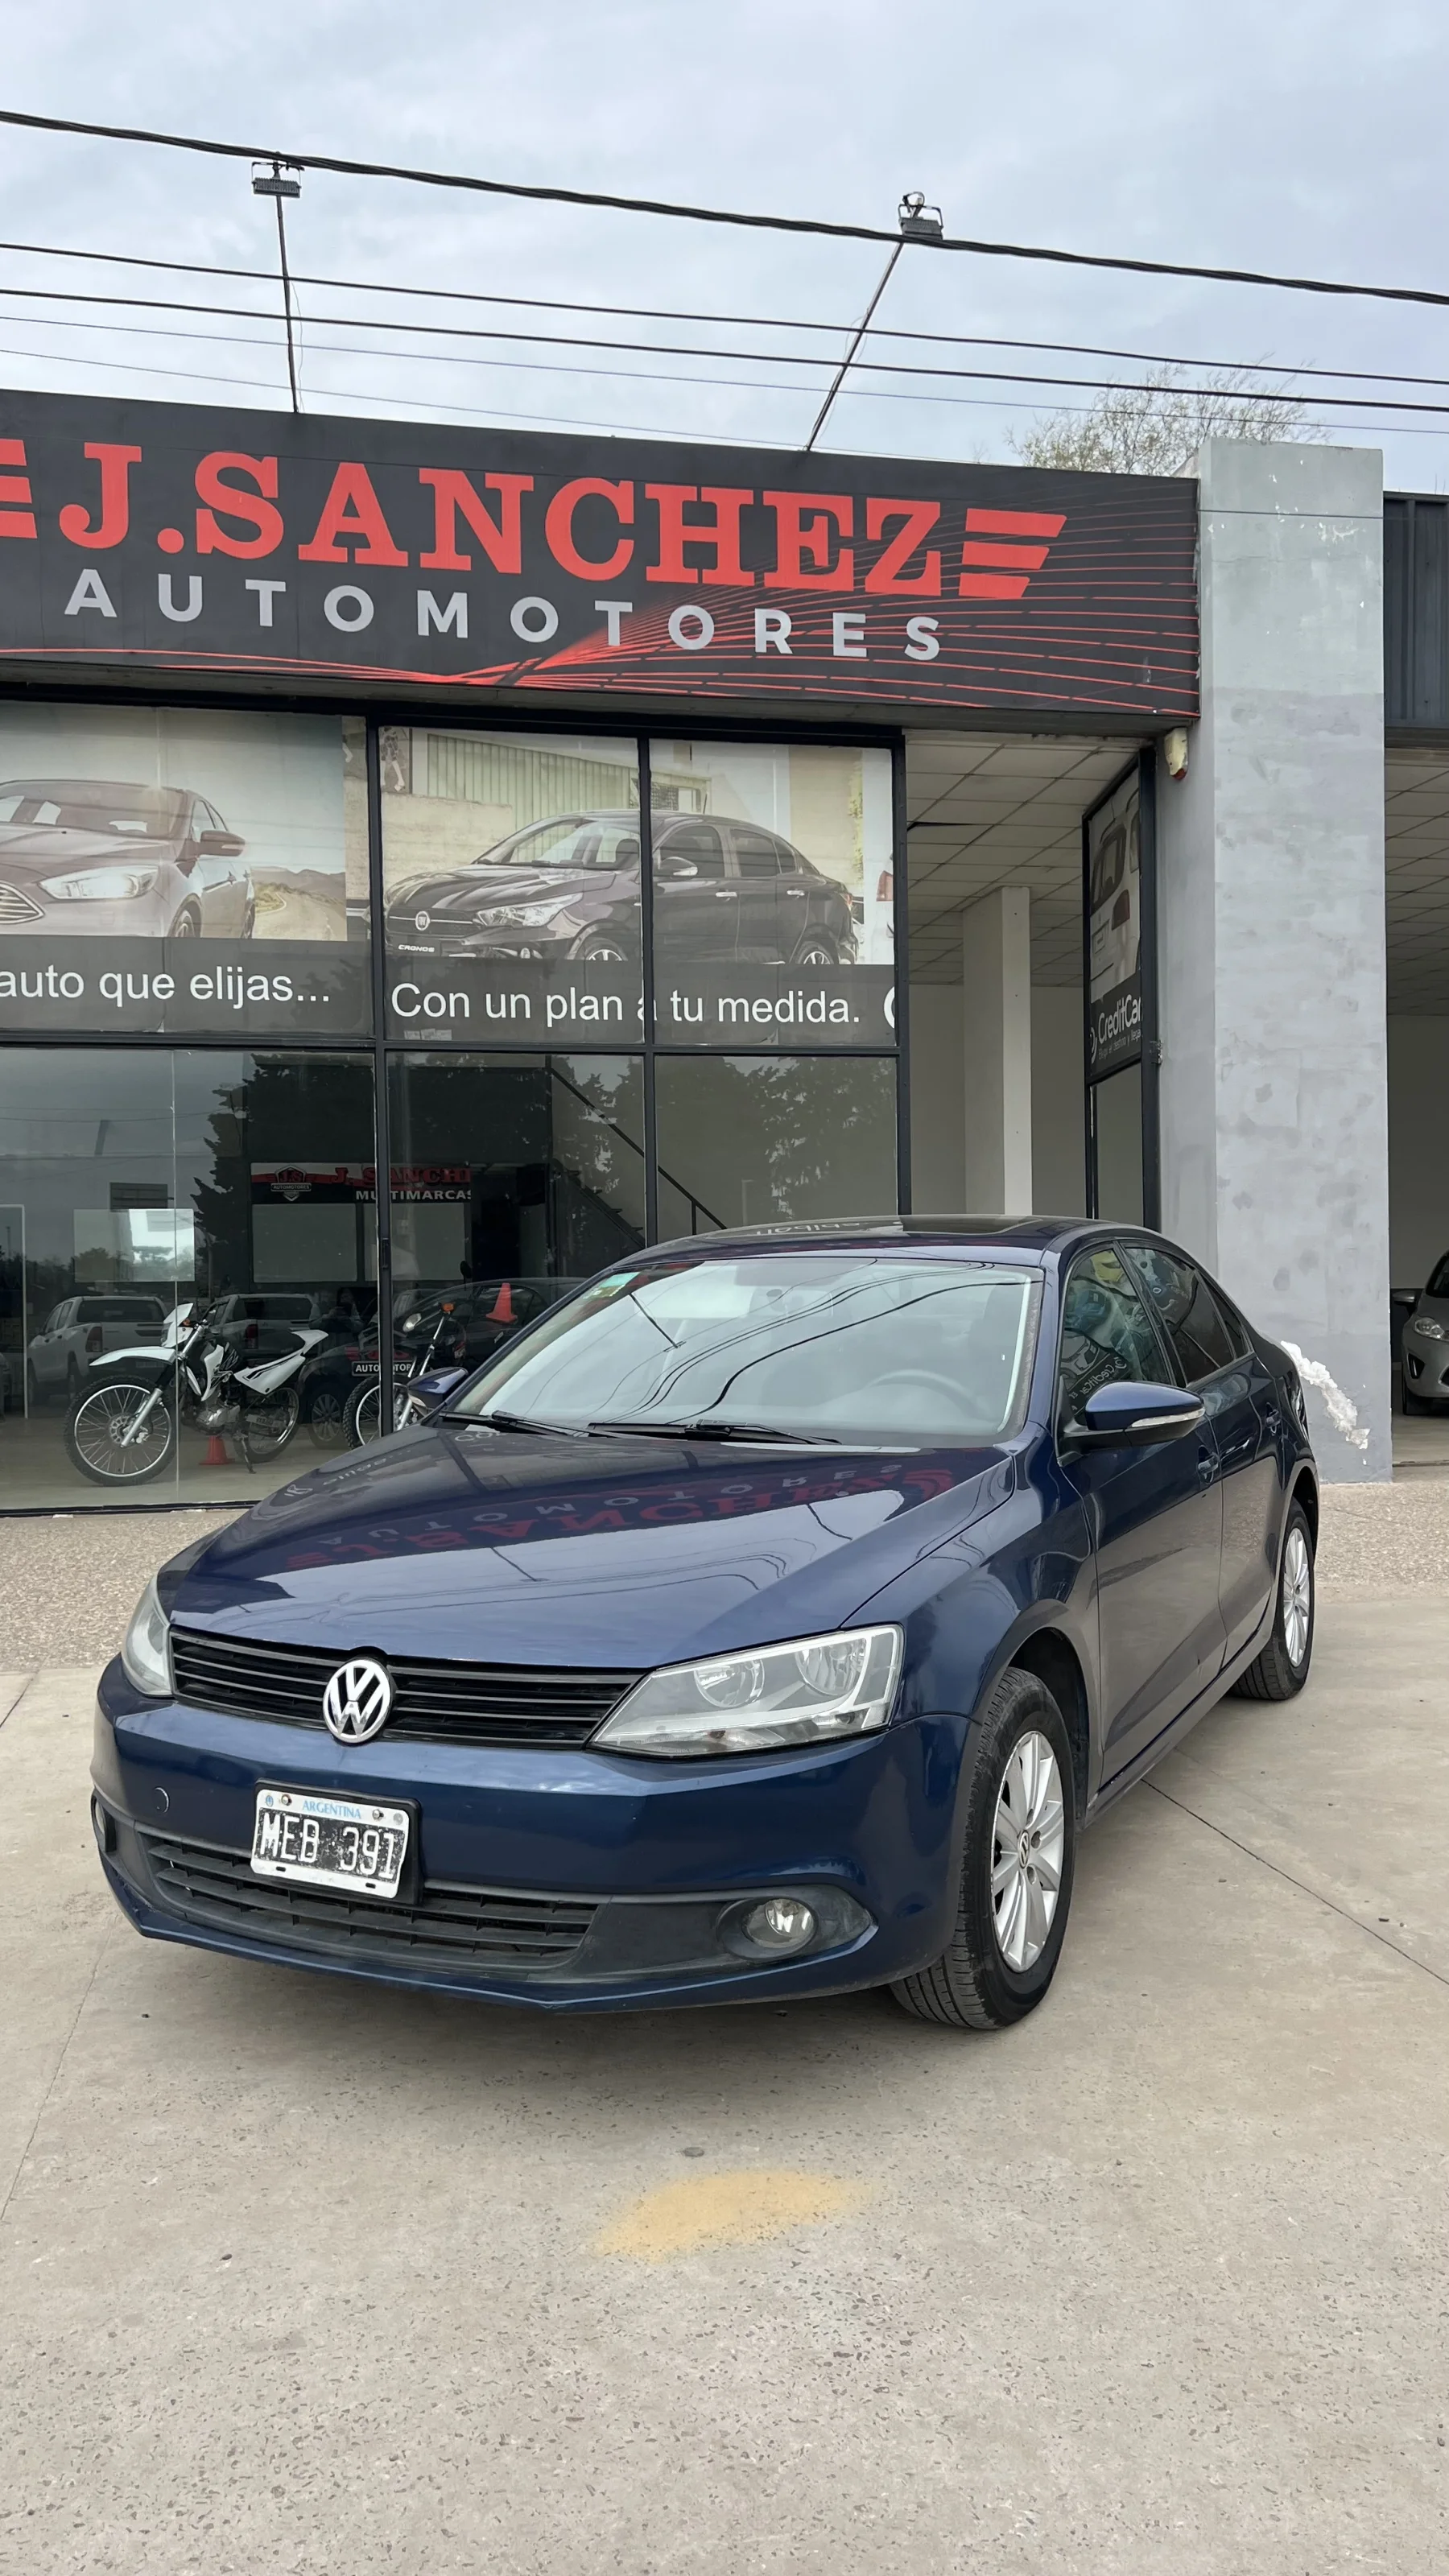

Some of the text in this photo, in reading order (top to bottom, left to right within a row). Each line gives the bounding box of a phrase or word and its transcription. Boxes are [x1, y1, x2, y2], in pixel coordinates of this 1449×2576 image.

[60, 442, 942, 597] J.SANCHEZ
[64, 568, 940, 662] AUTOMOTORES
[398, 944, 435, 952] CRONOS
[0, 964, 331, 1009] auto que elijas...
[391, 983, 470, 1018] Con
[485, 993, 530, 1018] un
[547, 987, 623, 1028] plan
[670, 989, 703, 1022] tu
[718, 991, 860, 1023] medida.
[356, 1190, 472, 1200] MUTIMARCAS
[302, 1800, 362, 1819] ARGENTINA
[259, 1813, 394, 1879] MEB 391
